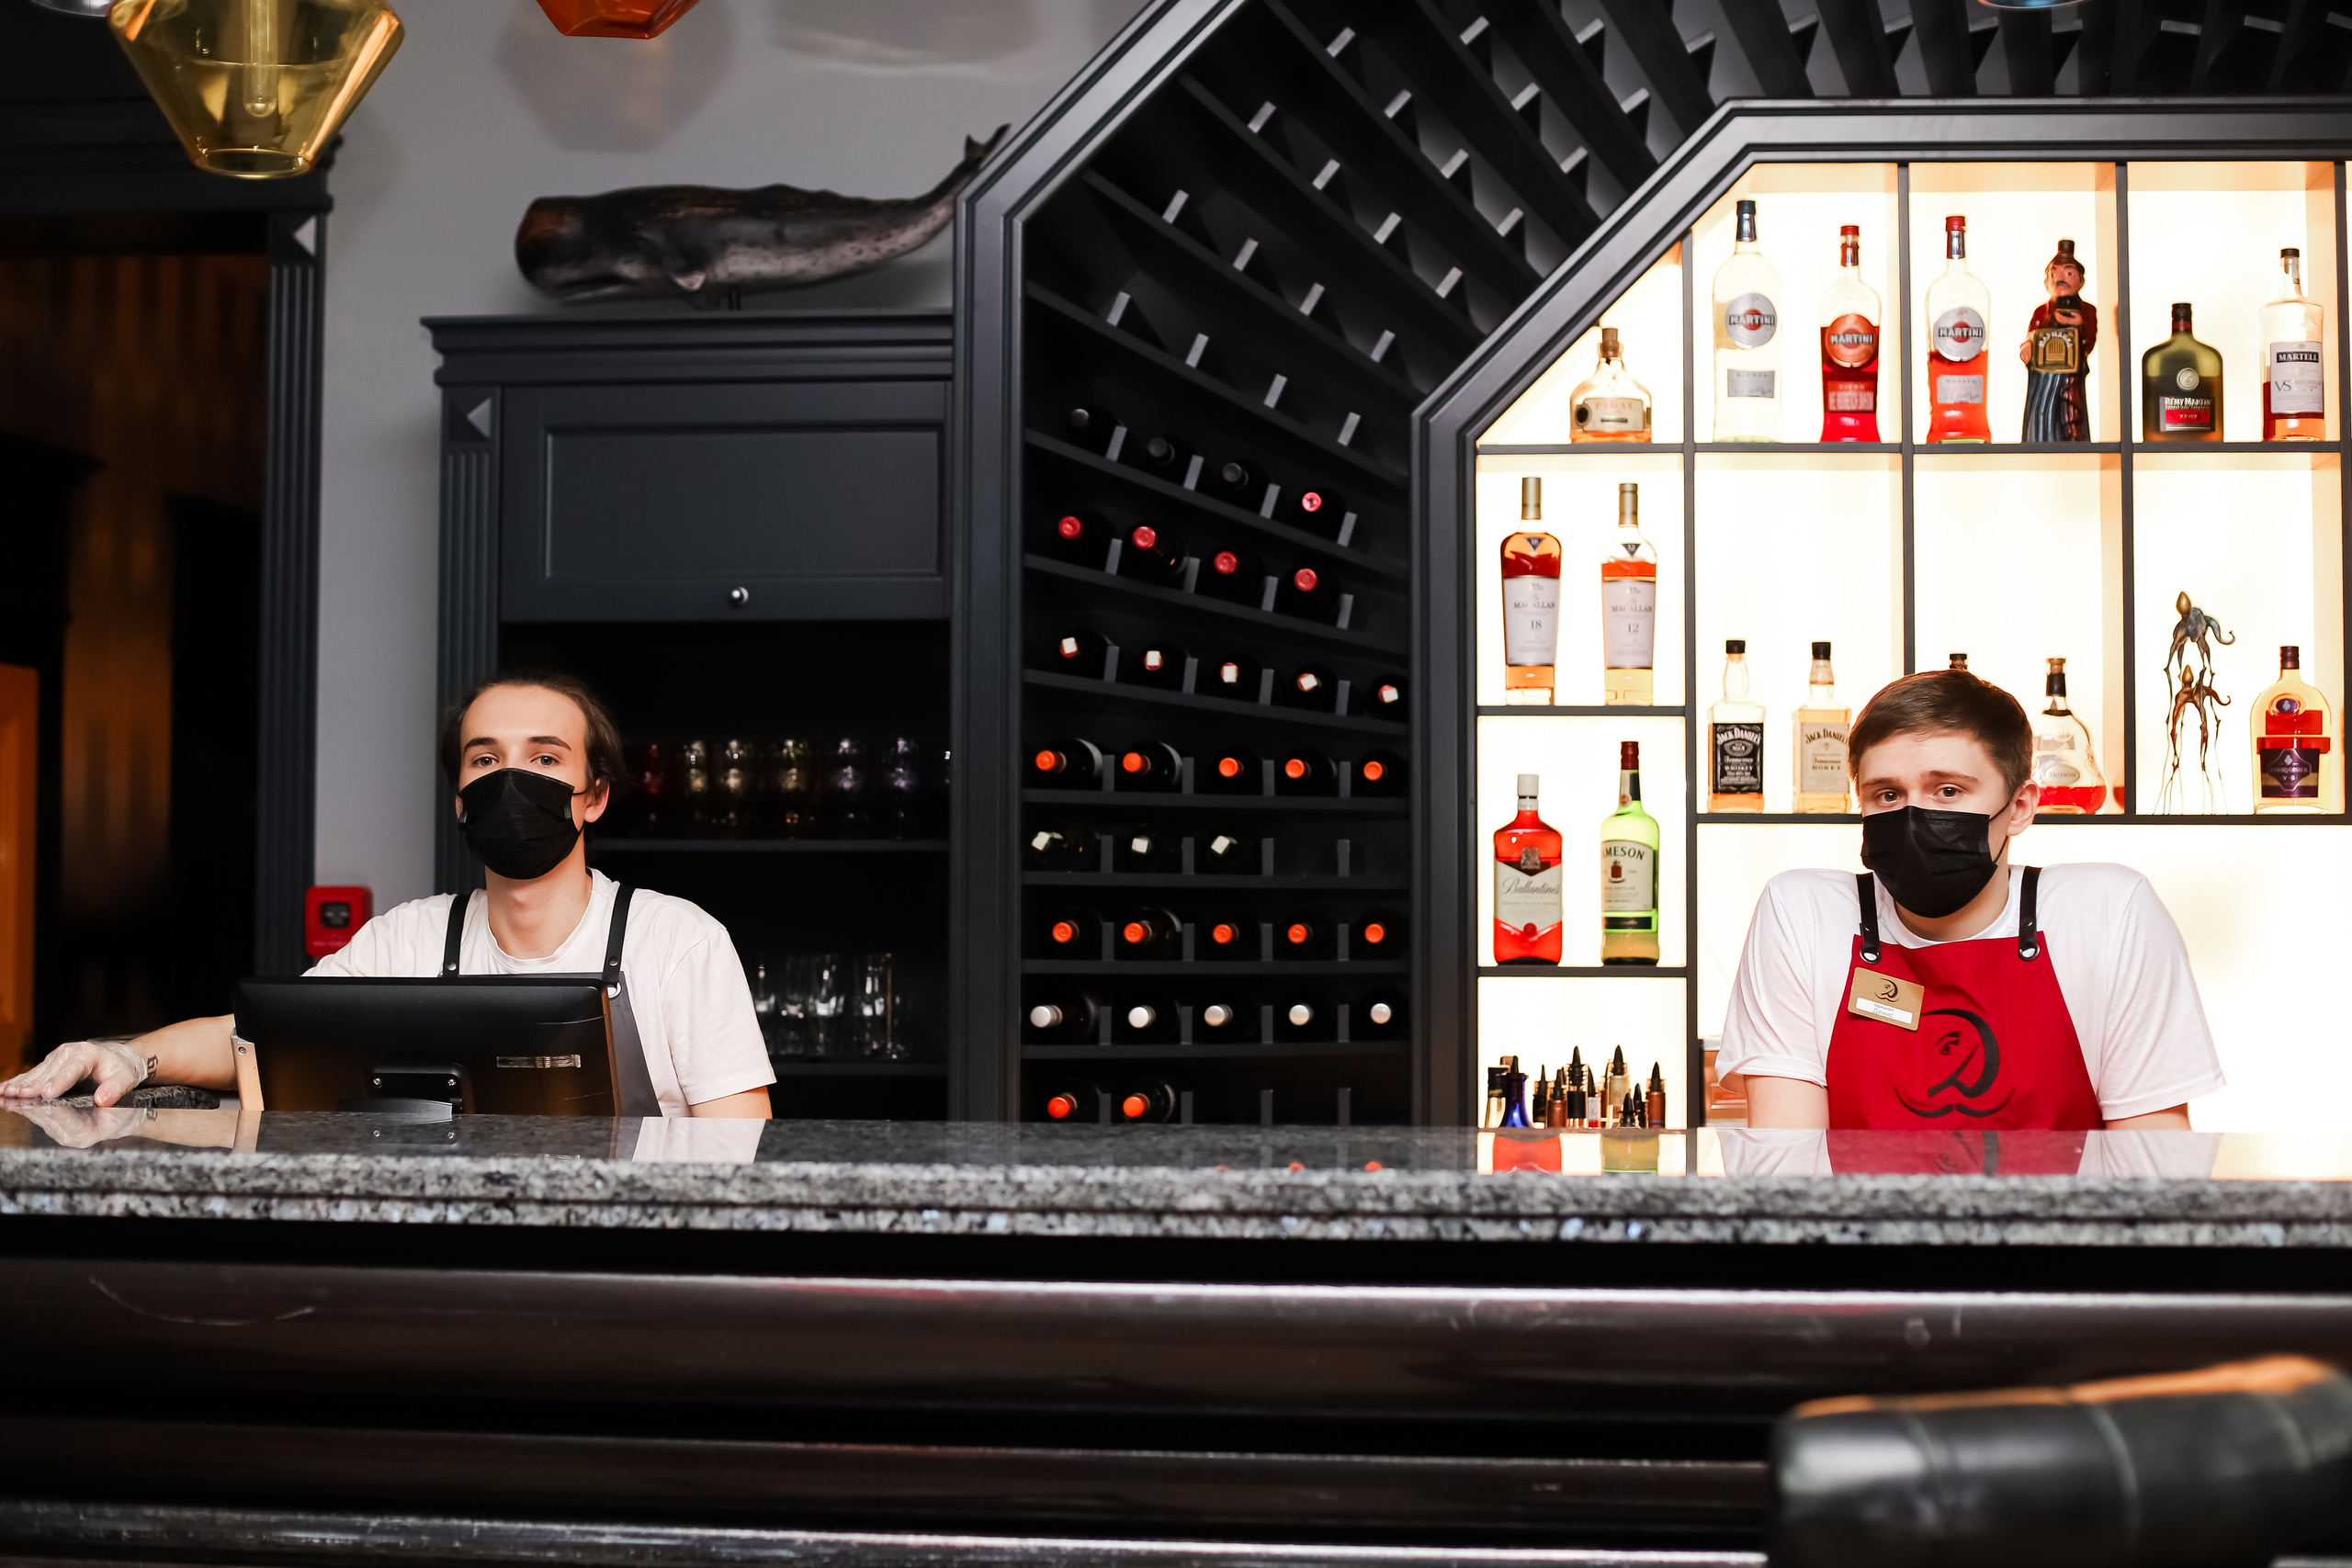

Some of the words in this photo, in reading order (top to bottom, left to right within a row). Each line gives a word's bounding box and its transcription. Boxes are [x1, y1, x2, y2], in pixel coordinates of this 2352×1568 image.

[1729, 314, 1775, 325] MARTINI
[1939, 327, 1983, 338] MARTINI
[1830, 333, 1873, 344] MARTINI
[2278, 353, 2318, 362] MARTELL
[2274, 379, 2292, 392] VS
[1513, 601, 1556, 609] MACALLAN
[1611, 604, 1654, 614] MACALLAN
[1531, 619, 1544, 629] 18
[1628, 623, 1640, 634] 12
[1805, 731, 1822, 744] JACK
[1602, 846, 1645, 861] MESON
